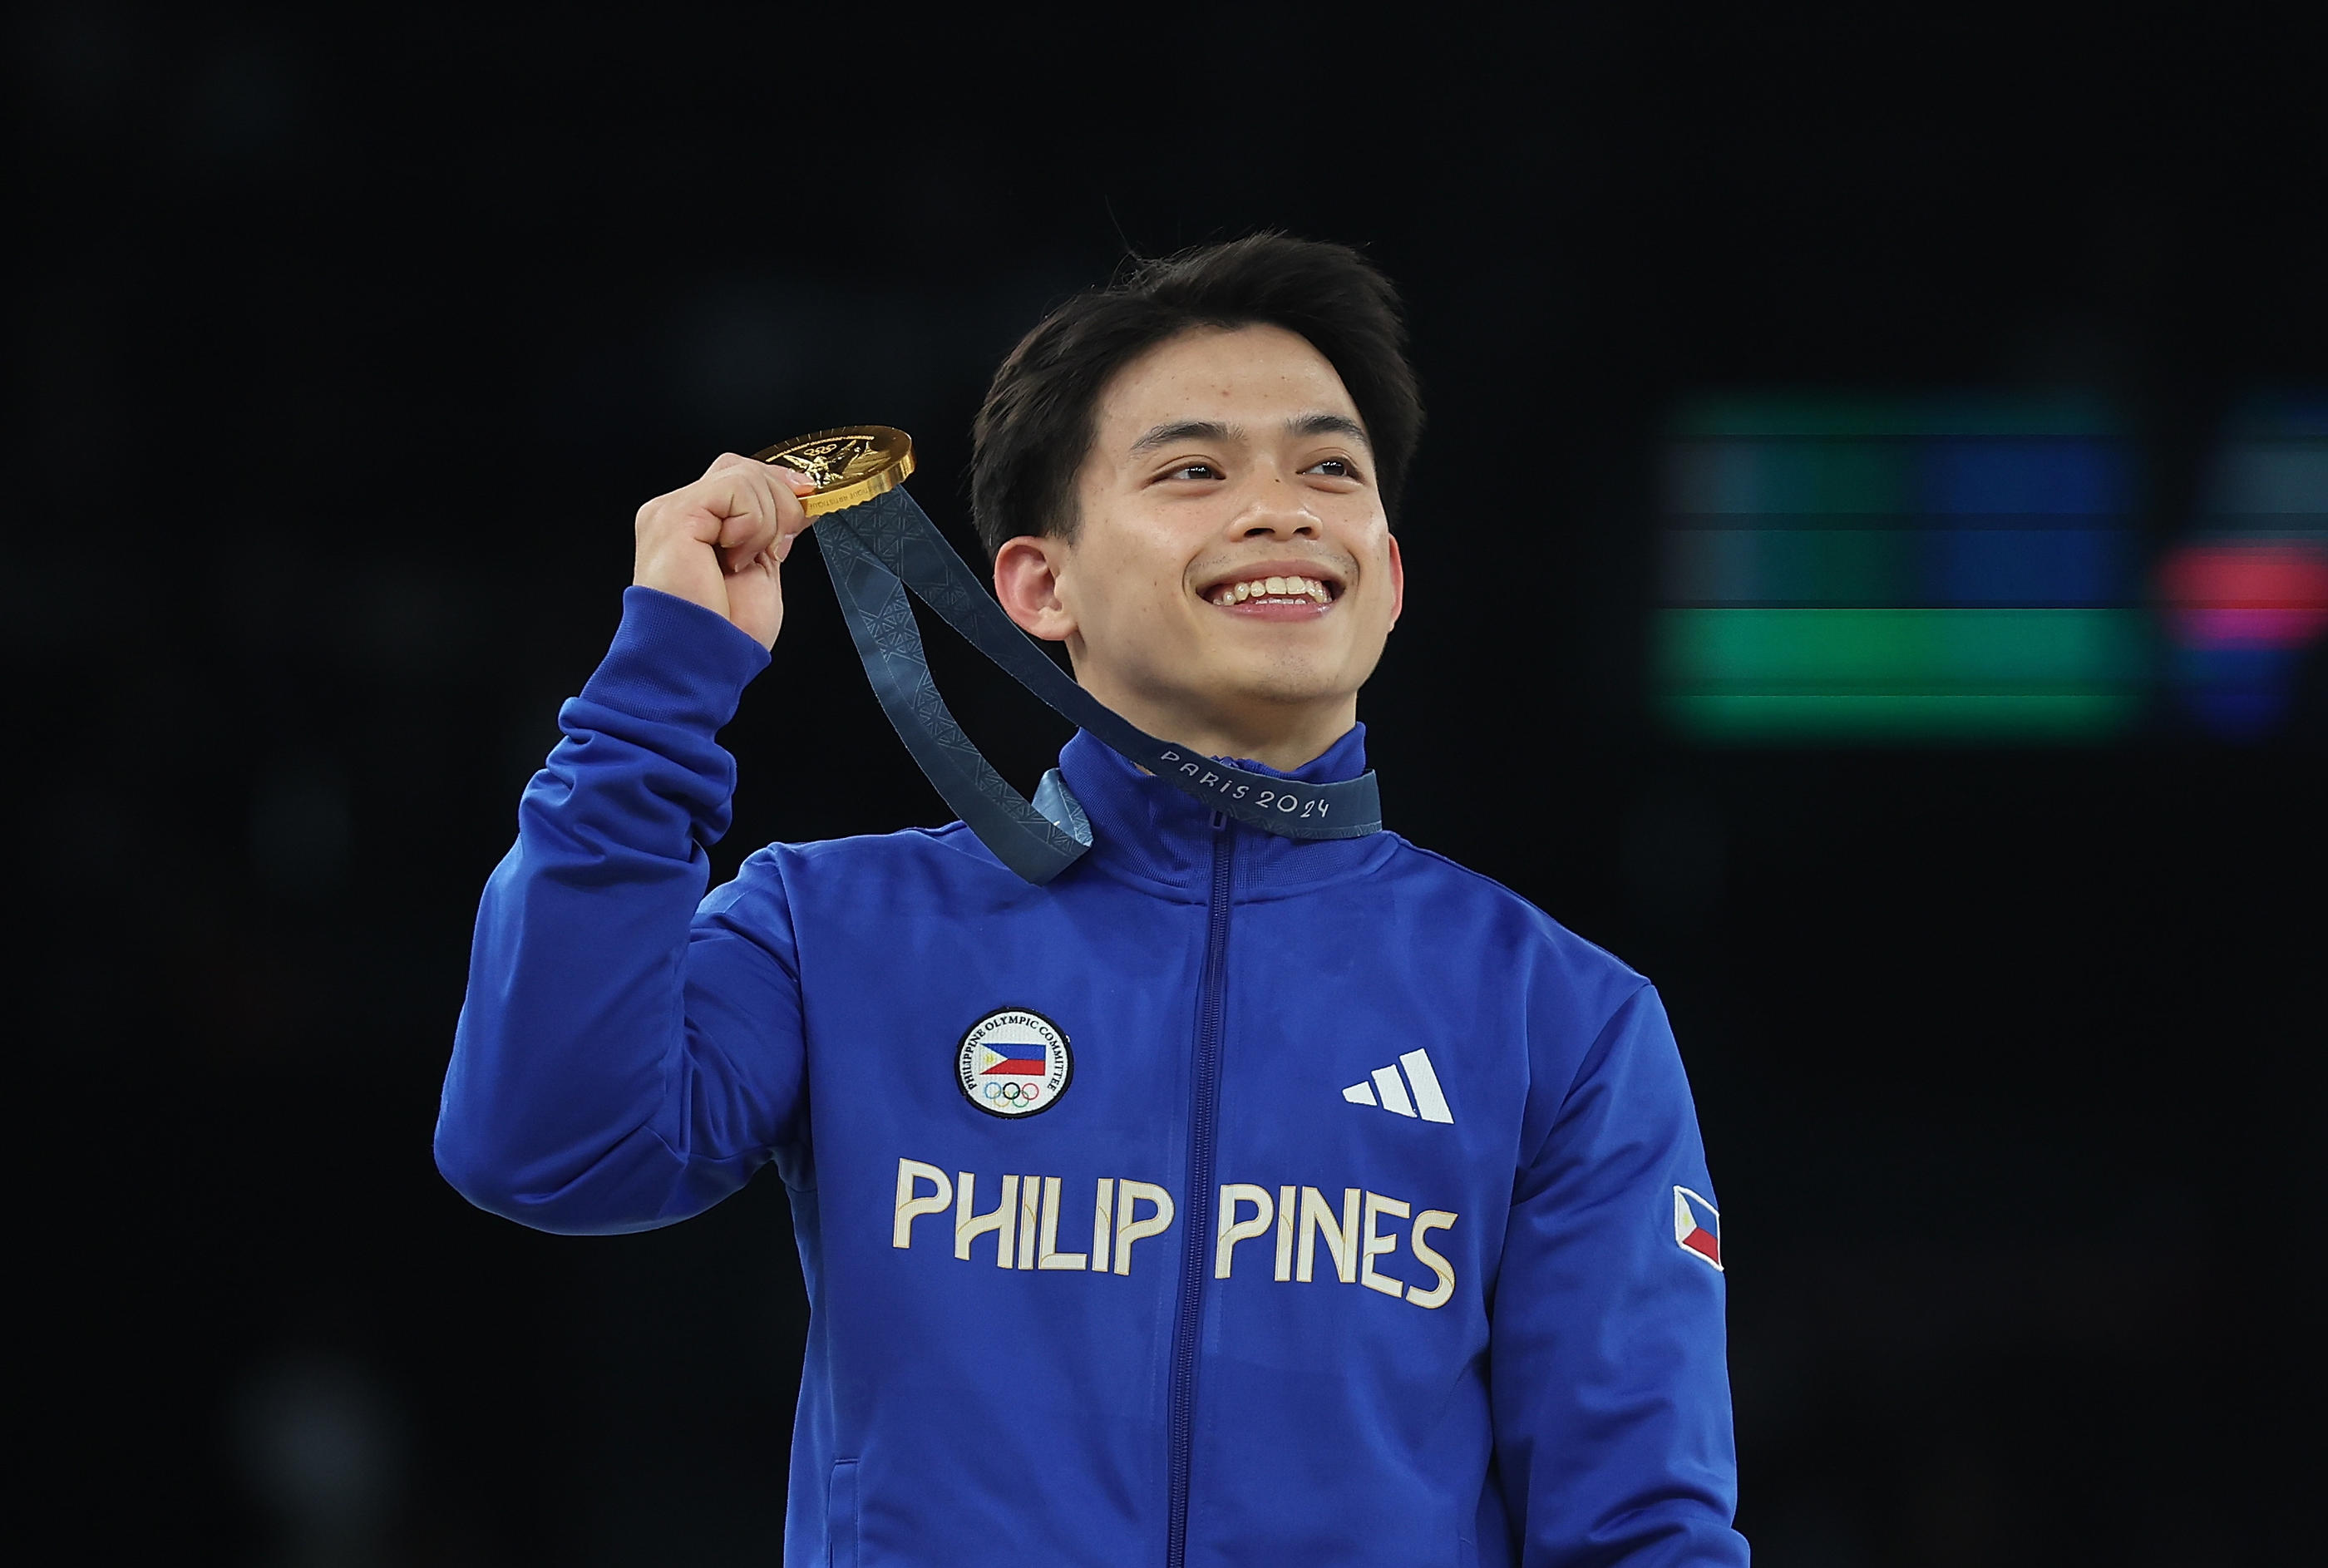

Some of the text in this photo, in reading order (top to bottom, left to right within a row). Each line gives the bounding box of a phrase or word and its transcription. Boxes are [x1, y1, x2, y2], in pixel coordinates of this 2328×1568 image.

[1255, 790, 1330, 818] 2024
[962, 1015, 1064, 1092] PHILIPPINE OLYMPIC COMMITTEE
